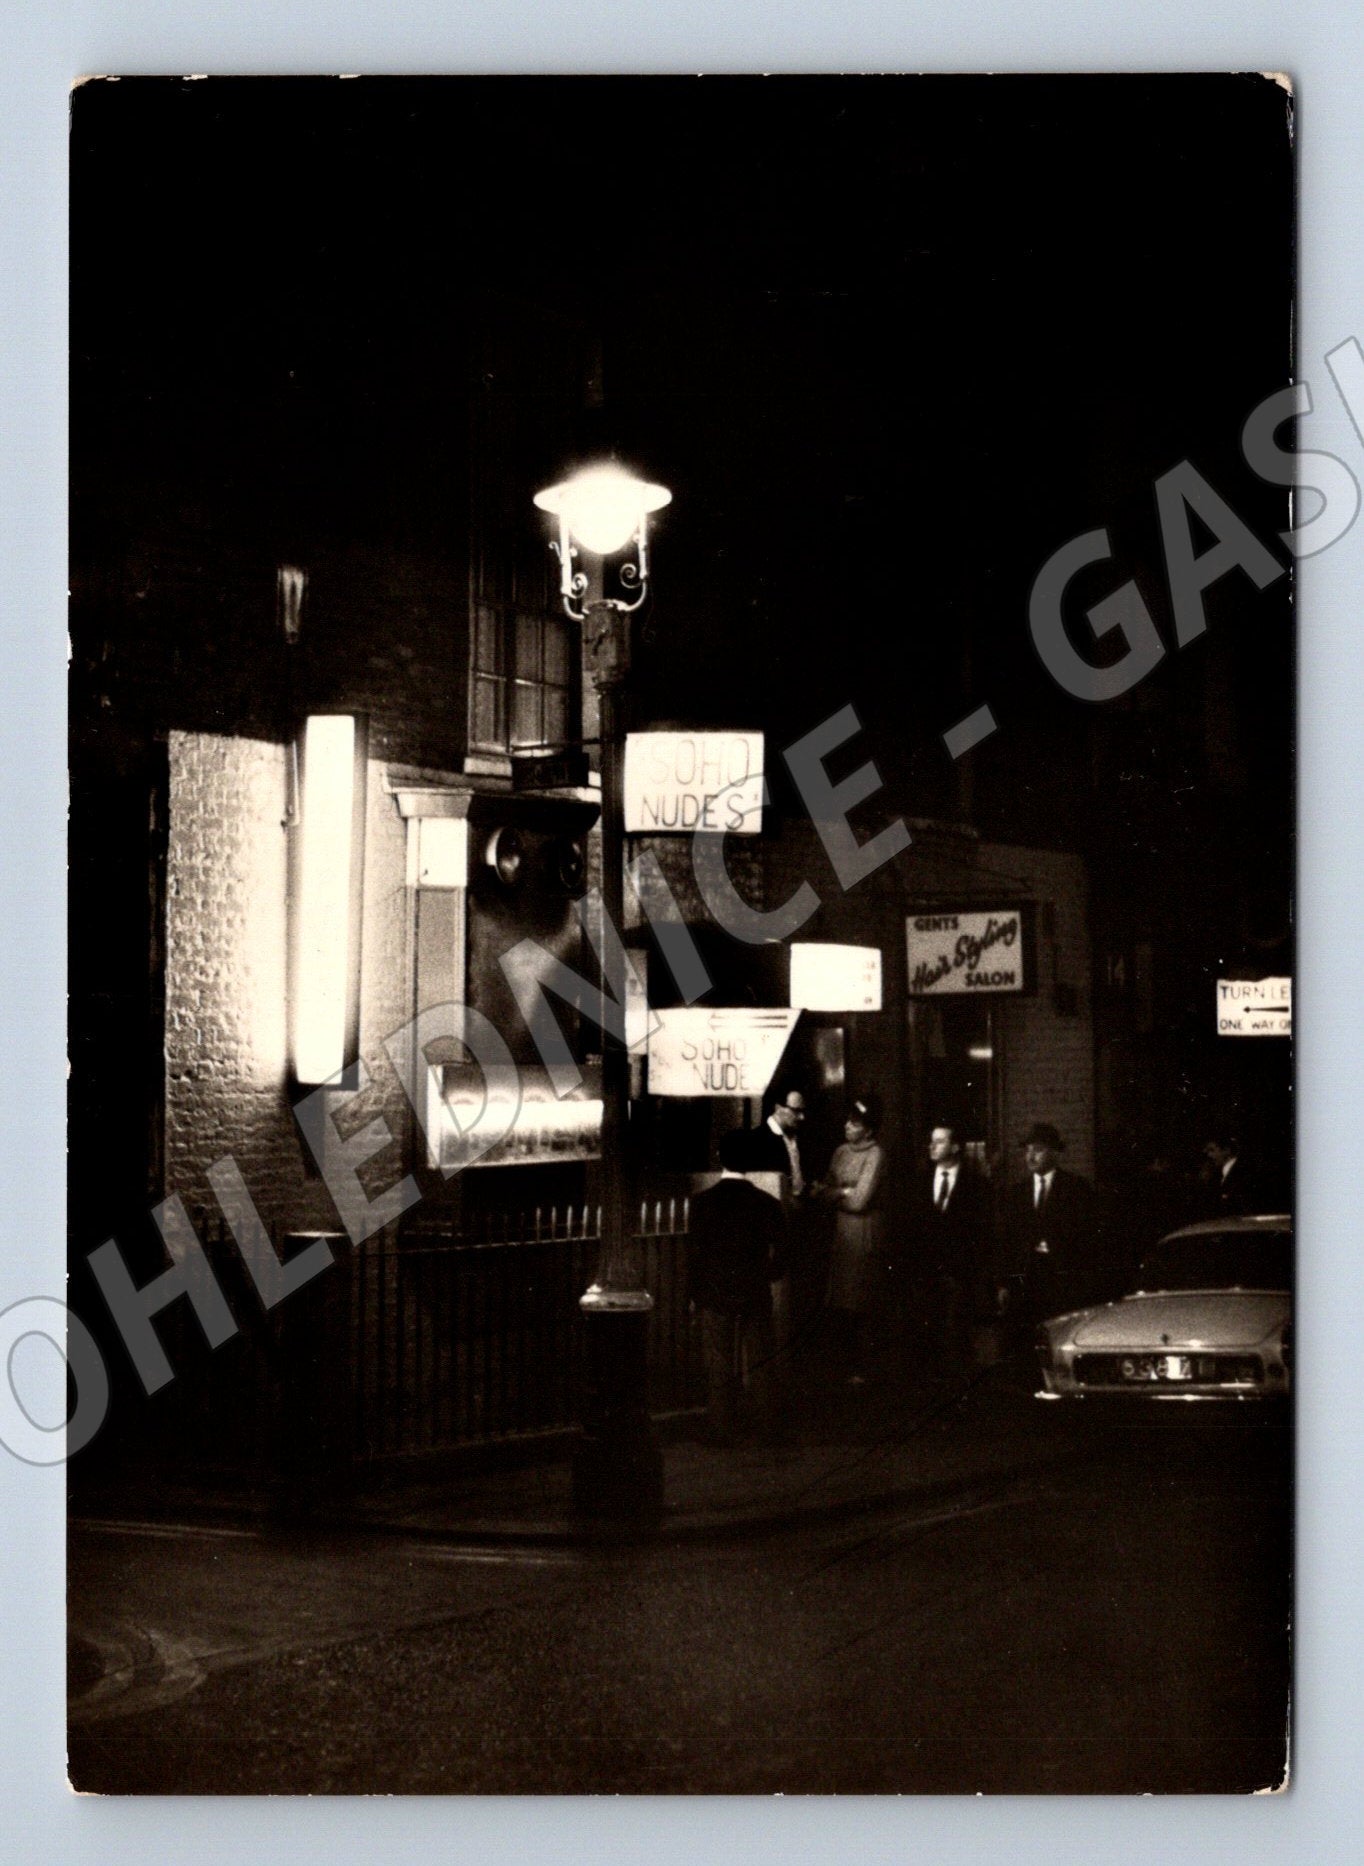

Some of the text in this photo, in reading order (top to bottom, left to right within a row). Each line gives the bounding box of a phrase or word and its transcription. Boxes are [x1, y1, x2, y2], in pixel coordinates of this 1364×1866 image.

[649, 738, 750, 787] SOHO
[640, 793, 745, 831] NUDES
[914, 916, 959, 931] GENTS
[953, 917, 1018, 970] Styling
[965, 971, 1015, 987] SALON
[1220, 985, 1265, 1000] TURN
[1219, 1019, 1243, 1031] ONE
[1251, 1019, 1275, 1030] WAY
[681, 1038, 747, 1061] SOHO
